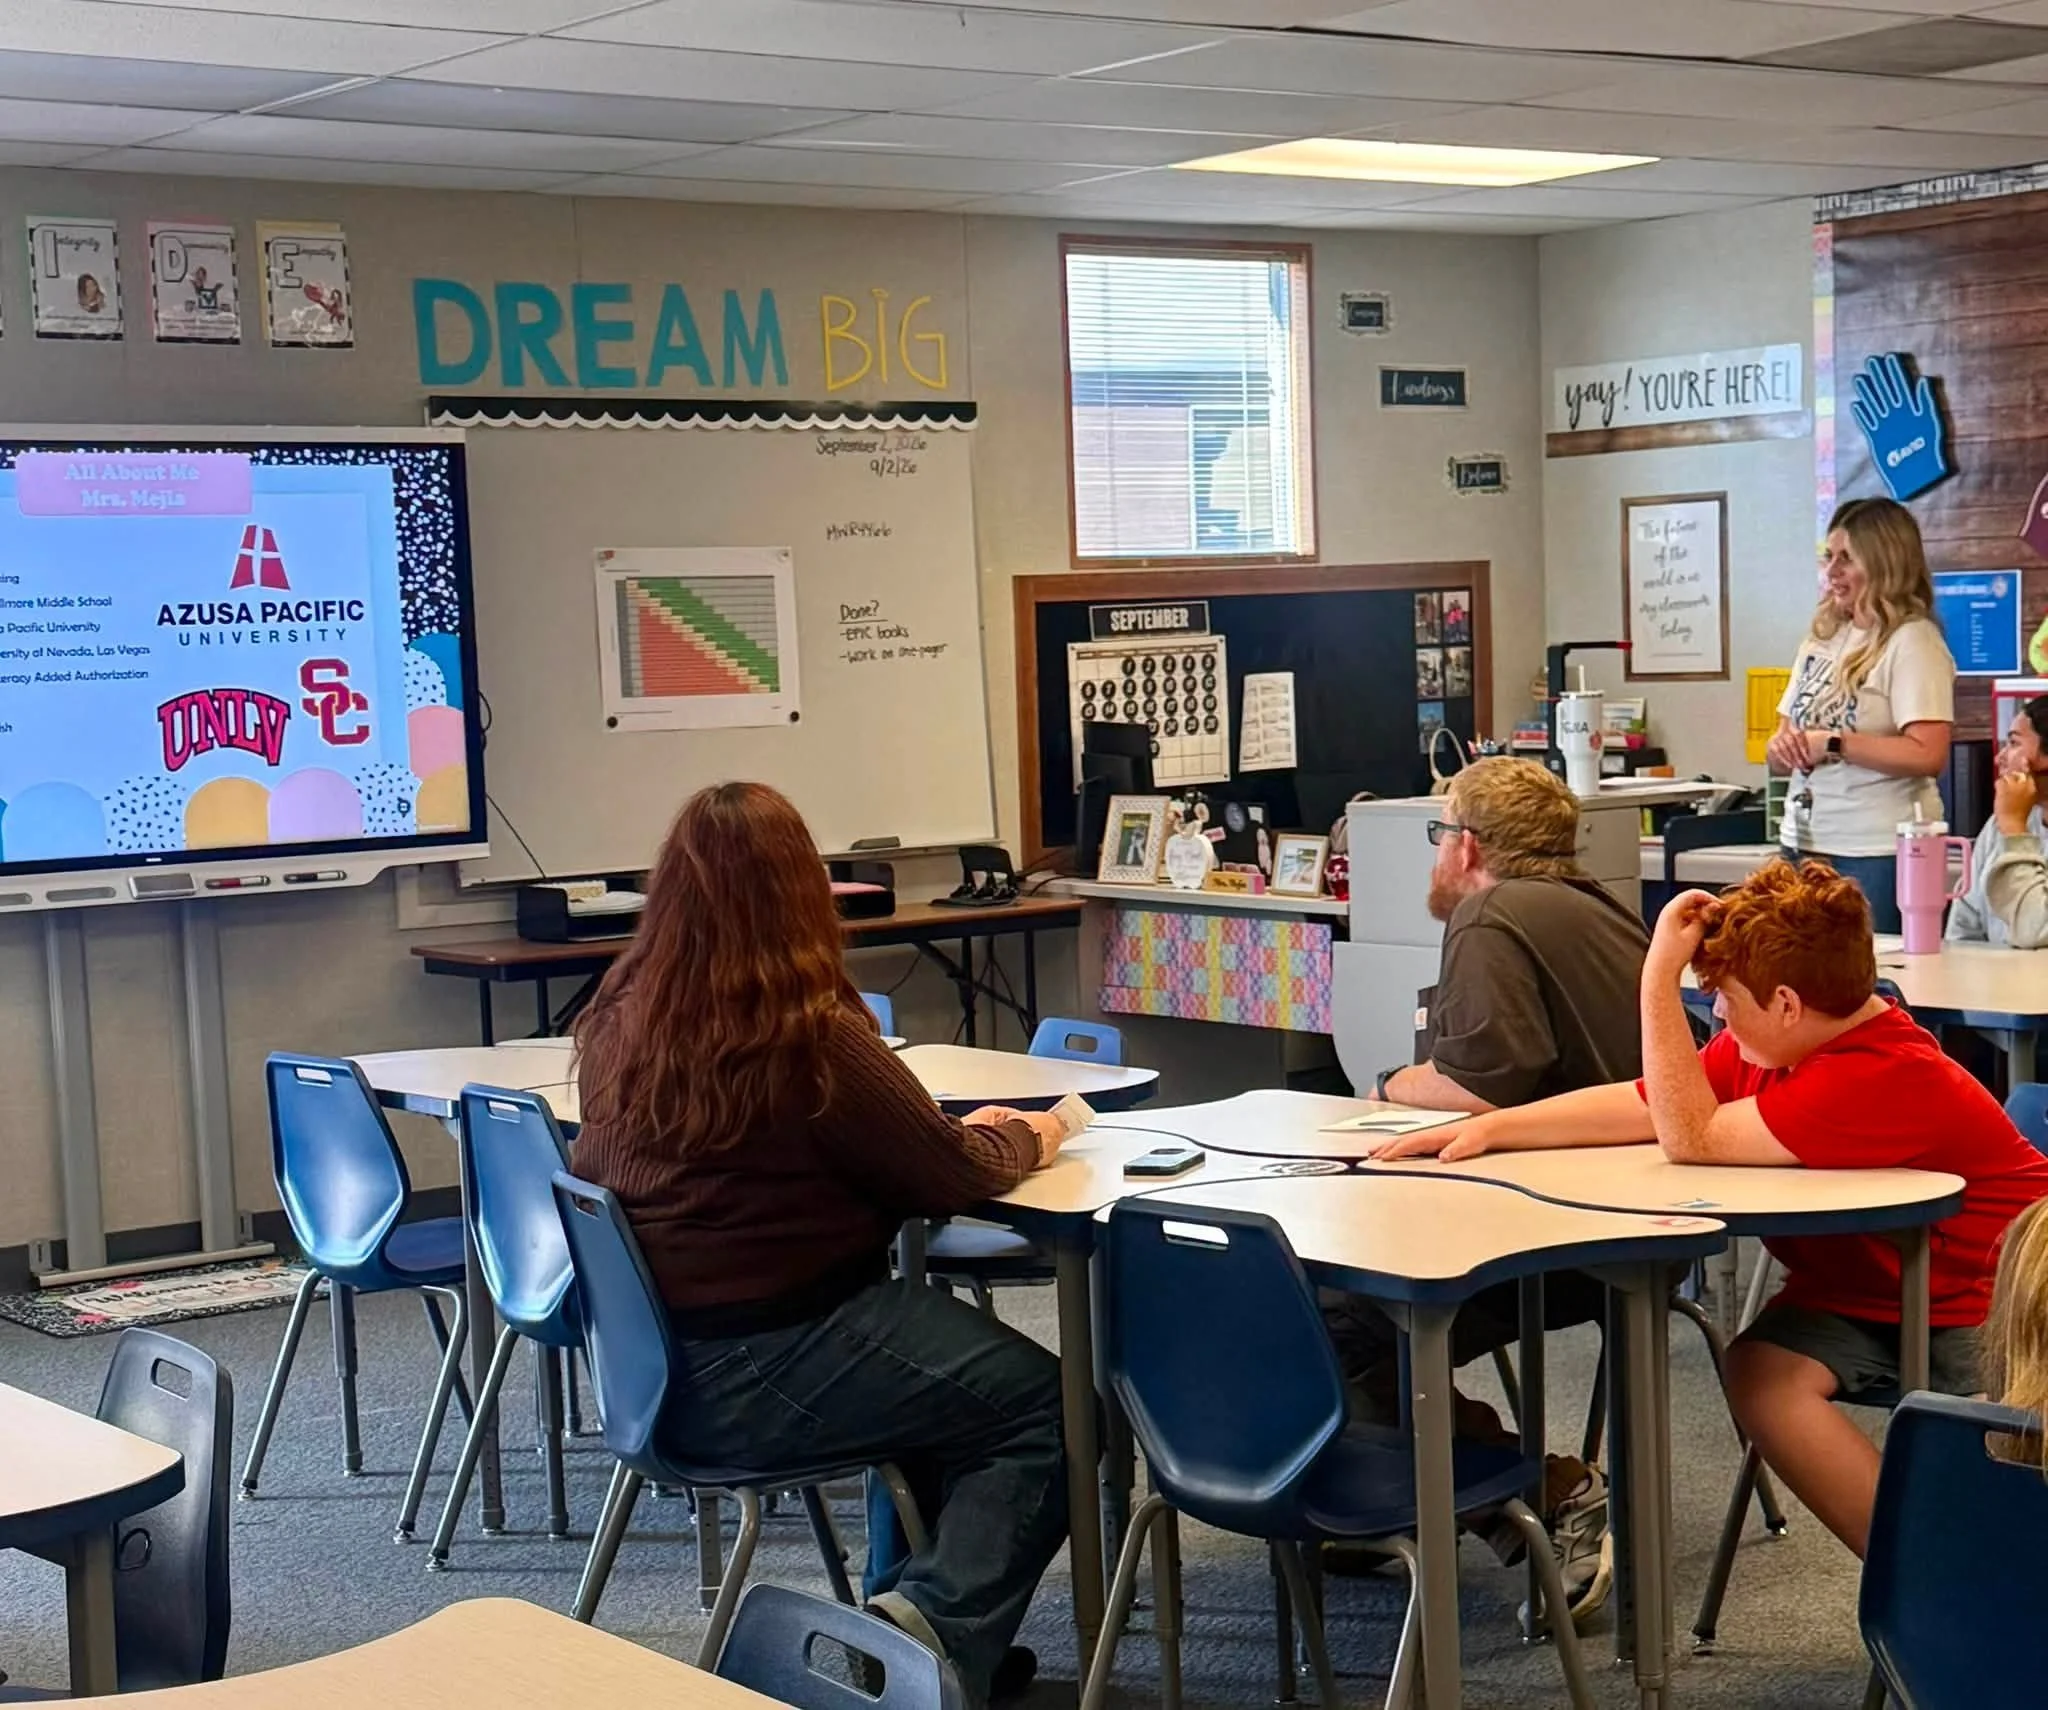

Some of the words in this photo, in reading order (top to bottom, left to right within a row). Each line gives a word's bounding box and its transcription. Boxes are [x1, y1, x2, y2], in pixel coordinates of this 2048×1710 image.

[412, 278, 789, 389] DREAM
[1565, 367, 1633, 430] yay!
[1639, 367, 1717, 412] YOU'RE
[1725, 360, 1792, 405] HERE!
[816, 435, 878, 456] September
[64, 463, 97, 480] All
[101, 463, 166, 480] About
[170, 463, 200, 480] Me
[81, 489, 127, 507] Mrs.
[130, 489, 186, 509] Mejia
[37, 596, 74, 608] Middle
[77, 595, 113, 607] School
[840, 600, 880, 620] Done?
[157, 602, 254, 626] AZUSA
[261, 600, 365, 623] PACIFIC
[1110, 608, 1189, 632] SEPTEMBER
[7, 622, 45, 634] Pacific
[47, 621, 100, 634] University
[178, 628, 347, 646] UNIVERSITY
[877, 624, 909, 639] books
[32, 647, 43, 657] of
[97, 645, 115, 656] Las
[117, 644, 151, 657] Vegas
[34, 671, 71, 683] Added
[74, 669, 149, 681] Authorization
[157, 688, 291, 772] UNLV
